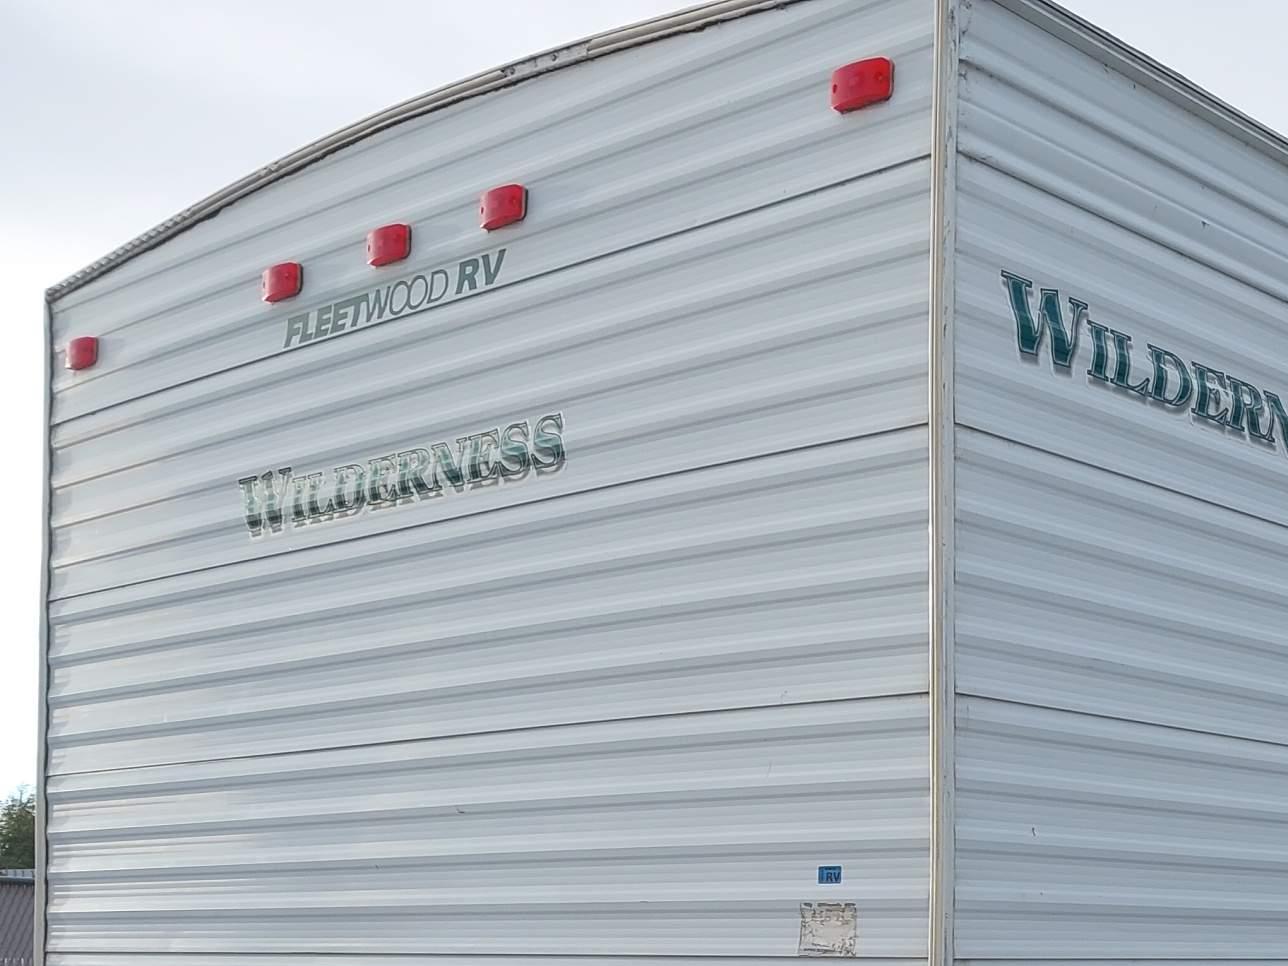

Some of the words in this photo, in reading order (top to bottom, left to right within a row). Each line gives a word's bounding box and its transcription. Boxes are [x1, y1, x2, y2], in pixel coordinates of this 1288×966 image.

[283, 268, 449, 348] FLEETWOOD
[455, 248, 507, 295] RV
[238, 412, 566, 533] WILDERNESS
